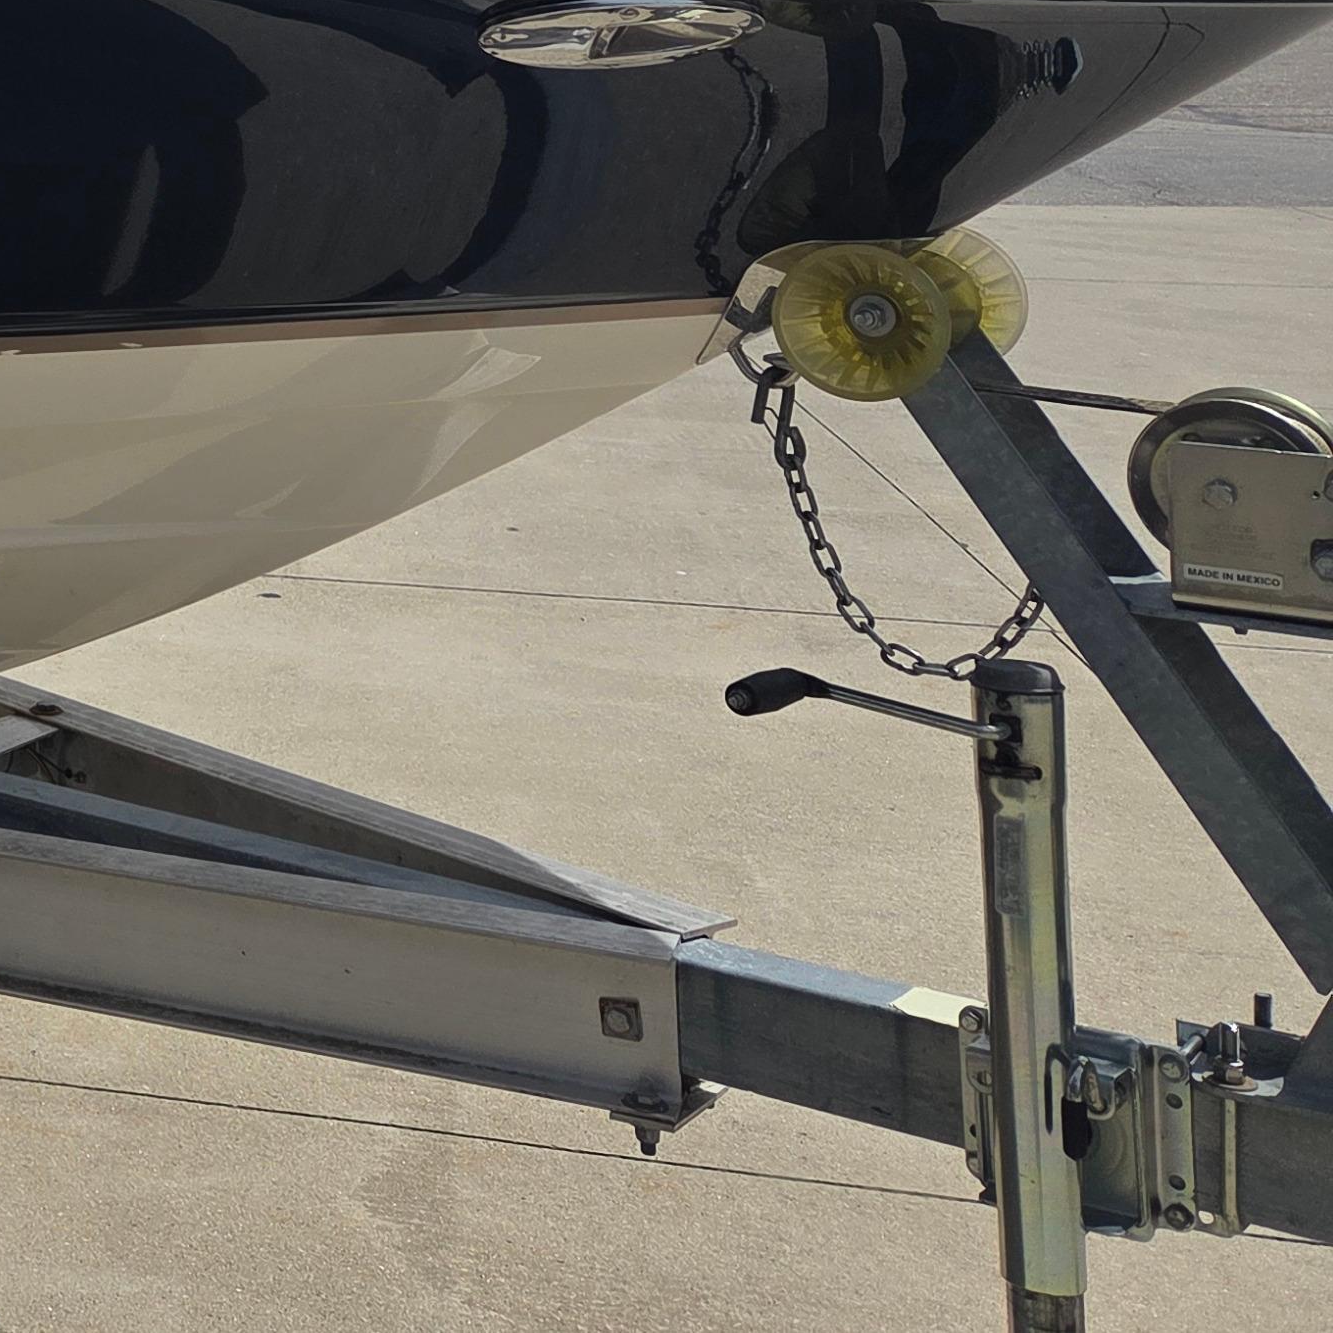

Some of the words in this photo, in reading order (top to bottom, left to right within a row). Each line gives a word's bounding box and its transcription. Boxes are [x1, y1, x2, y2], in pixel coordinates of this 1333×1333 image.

[1187, 567, 1220, 579] MADE
[1222, 572, 1234, 581] IN
[1236, 573, 1281, 587] MEXICO
